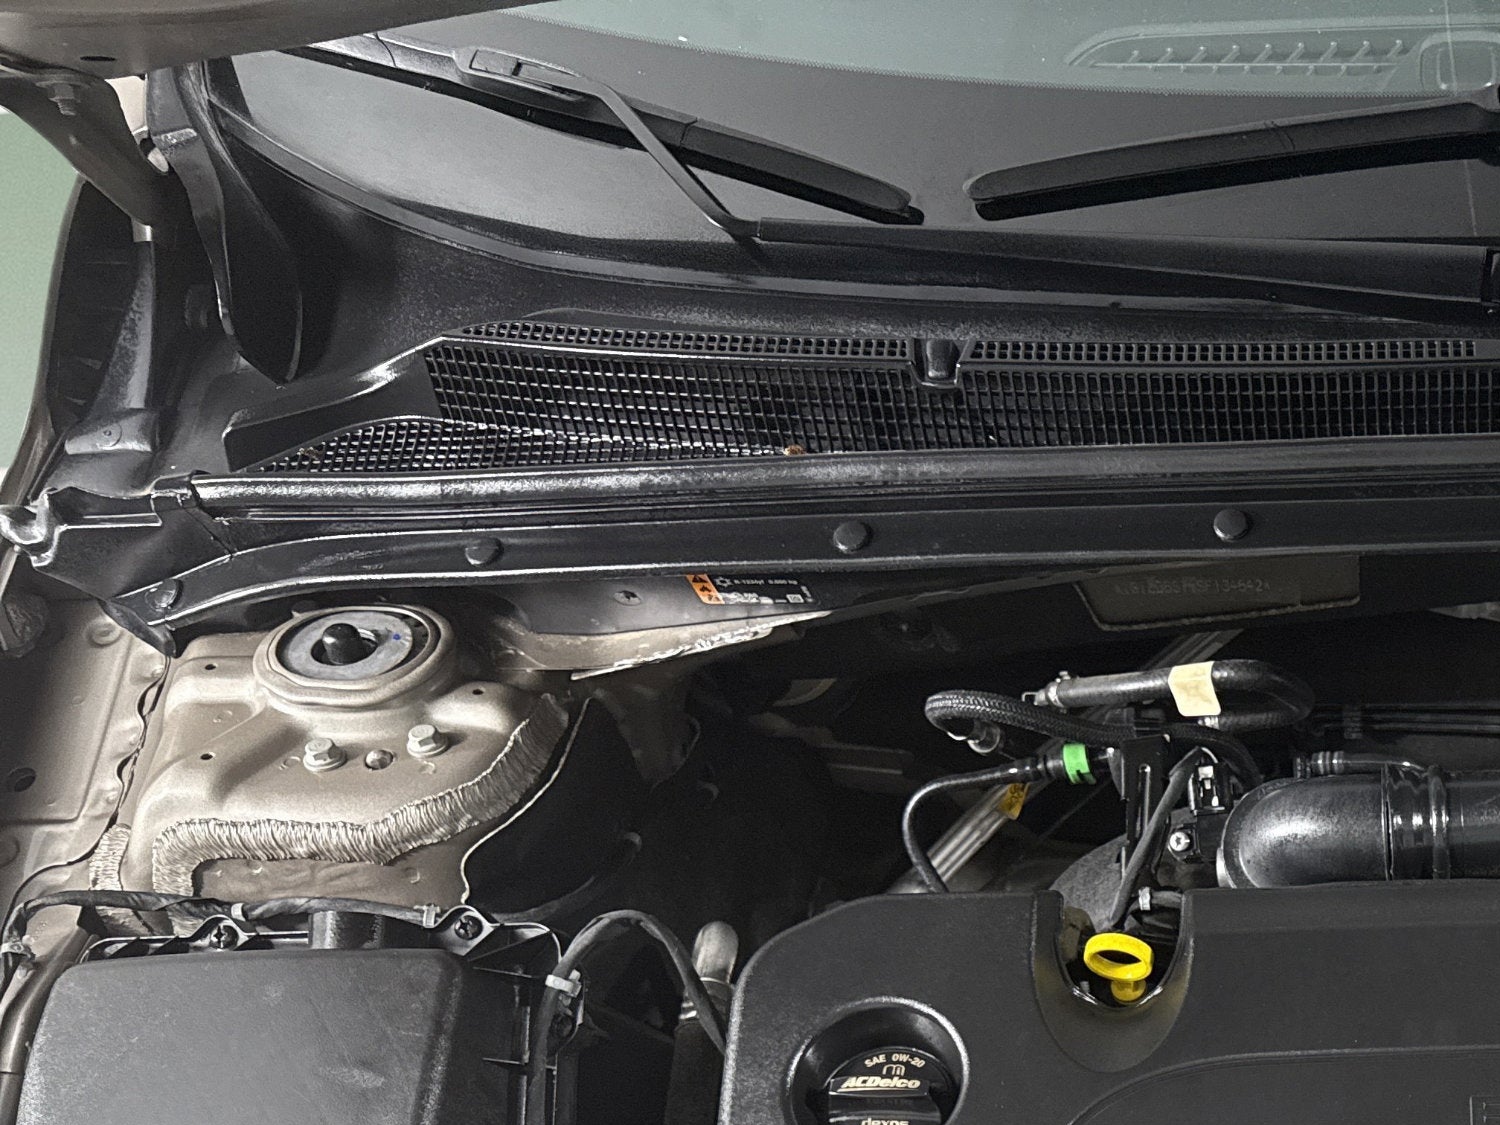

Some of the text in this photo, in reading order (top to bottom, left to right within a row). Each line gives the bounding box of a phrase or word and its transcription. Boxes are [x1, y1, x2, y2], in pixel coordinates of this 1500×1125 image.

[864, 1053, 926, 1068] SAE 0W-20
[840, 1076, 921, 1089] ACDelco
